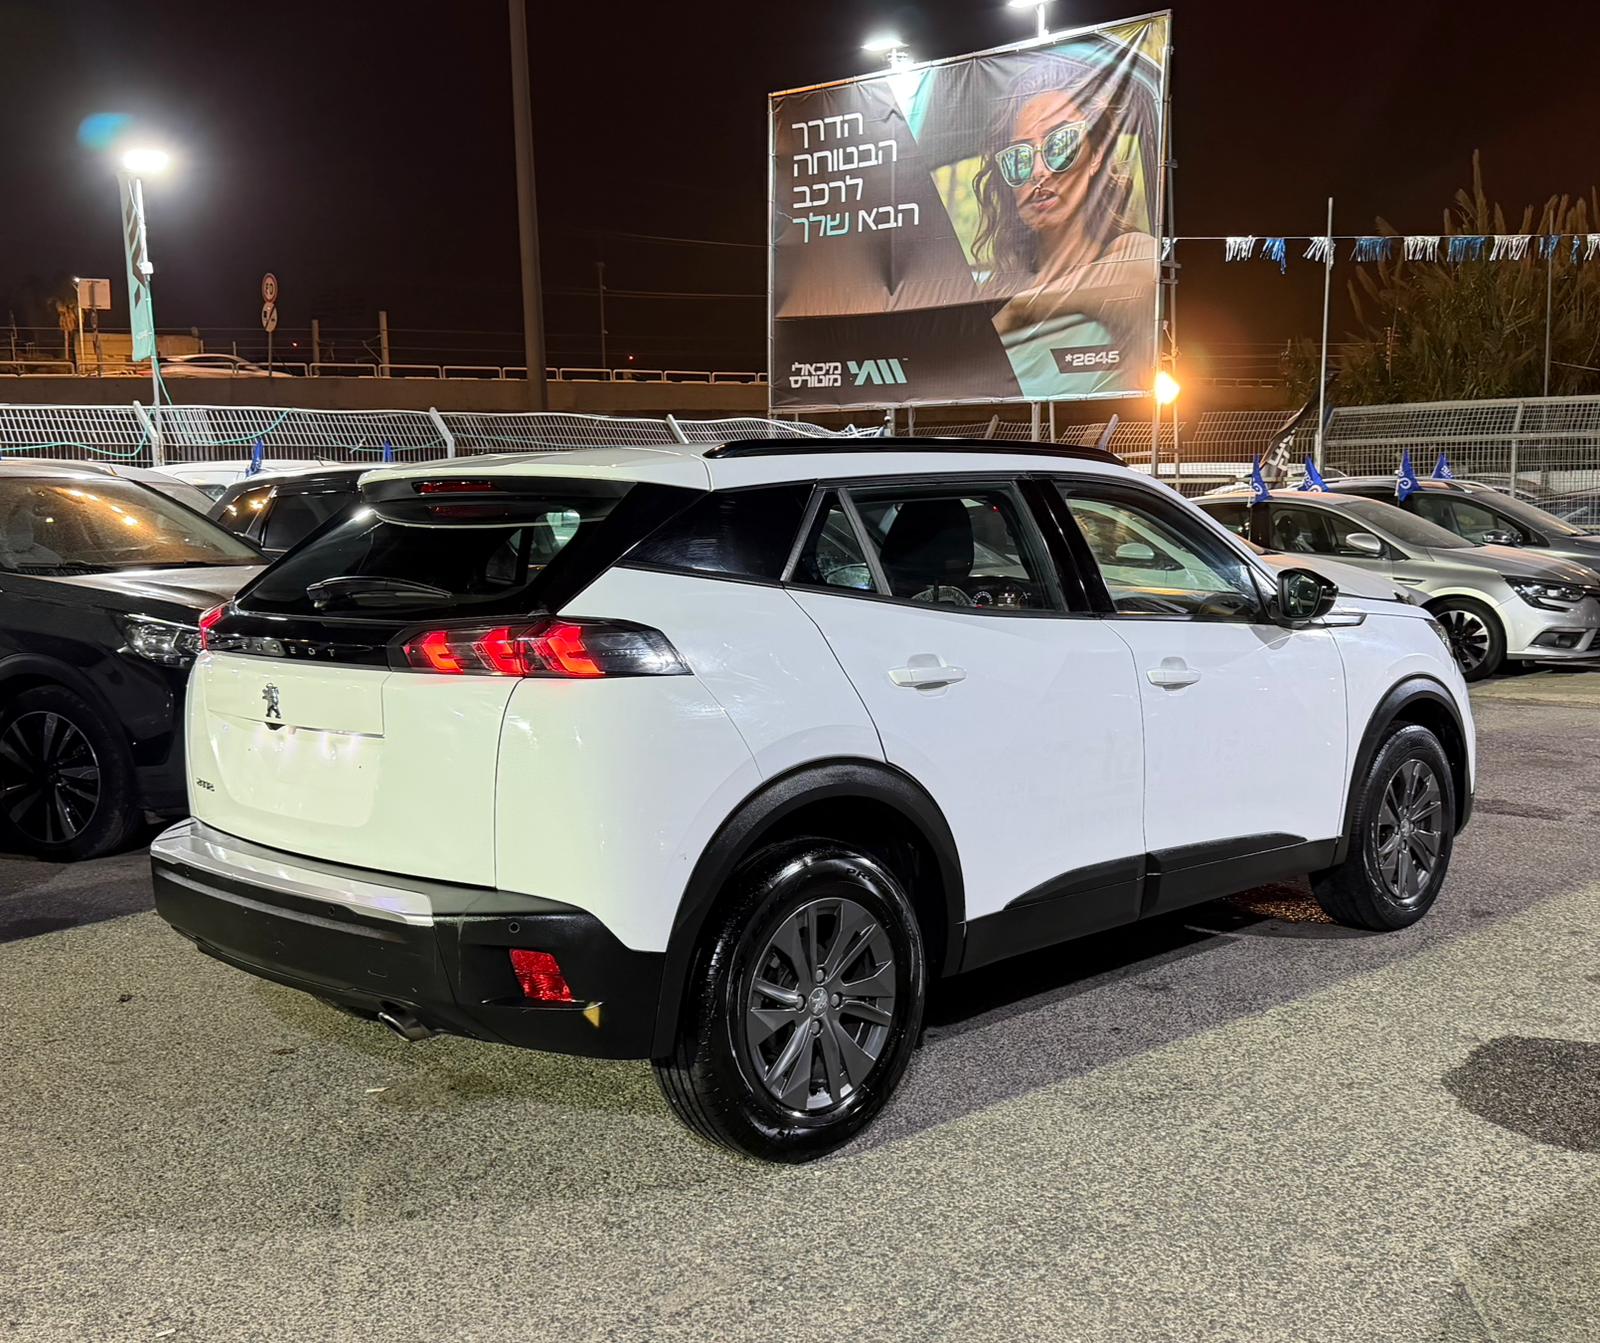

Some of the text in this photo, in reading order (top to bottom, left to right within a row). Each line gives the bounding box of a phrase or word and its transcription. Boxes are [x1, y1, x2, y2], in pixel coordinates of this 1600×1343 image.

[792, 112, 863, 148] הדרך
[793, 139, 897, 177] הבטוחה
[793, 175, 864, 208] לרכב
[792, 202, 919, 243] הבא שלך
[789, 374, 841, 388] מוטורס
[791, 361, 841, 376] מיכאלי
